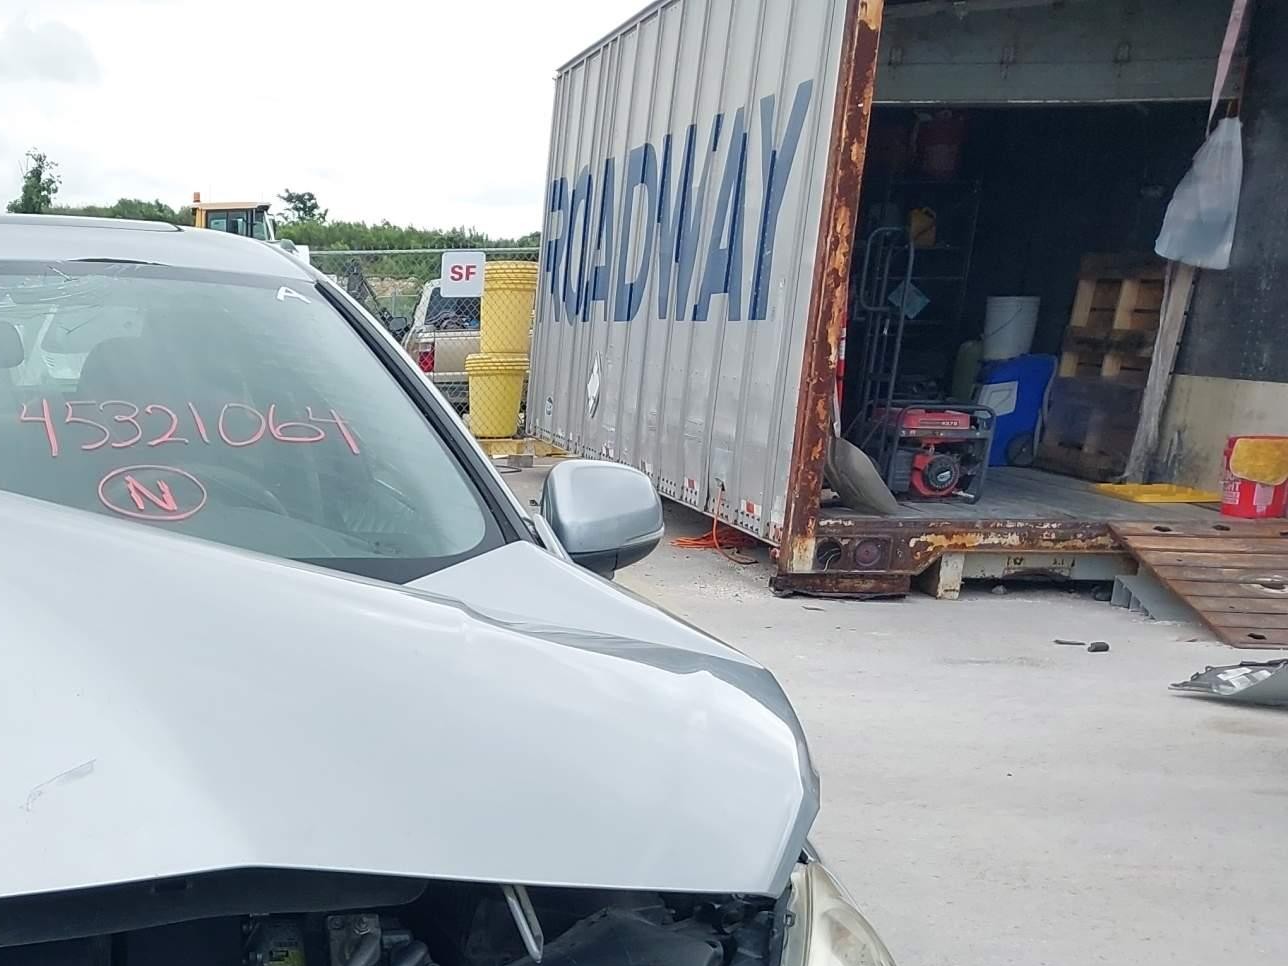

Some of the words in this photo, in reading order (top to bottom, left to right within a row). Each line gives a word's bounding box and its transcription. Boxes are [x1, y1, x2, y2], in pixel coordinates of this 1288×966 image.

[540, 79, 813, 325] ROADWAY
[450, 264, 477, 282] SF
[20, 399, 360, 457] 45321064
[124, 474, 177, 511] N
